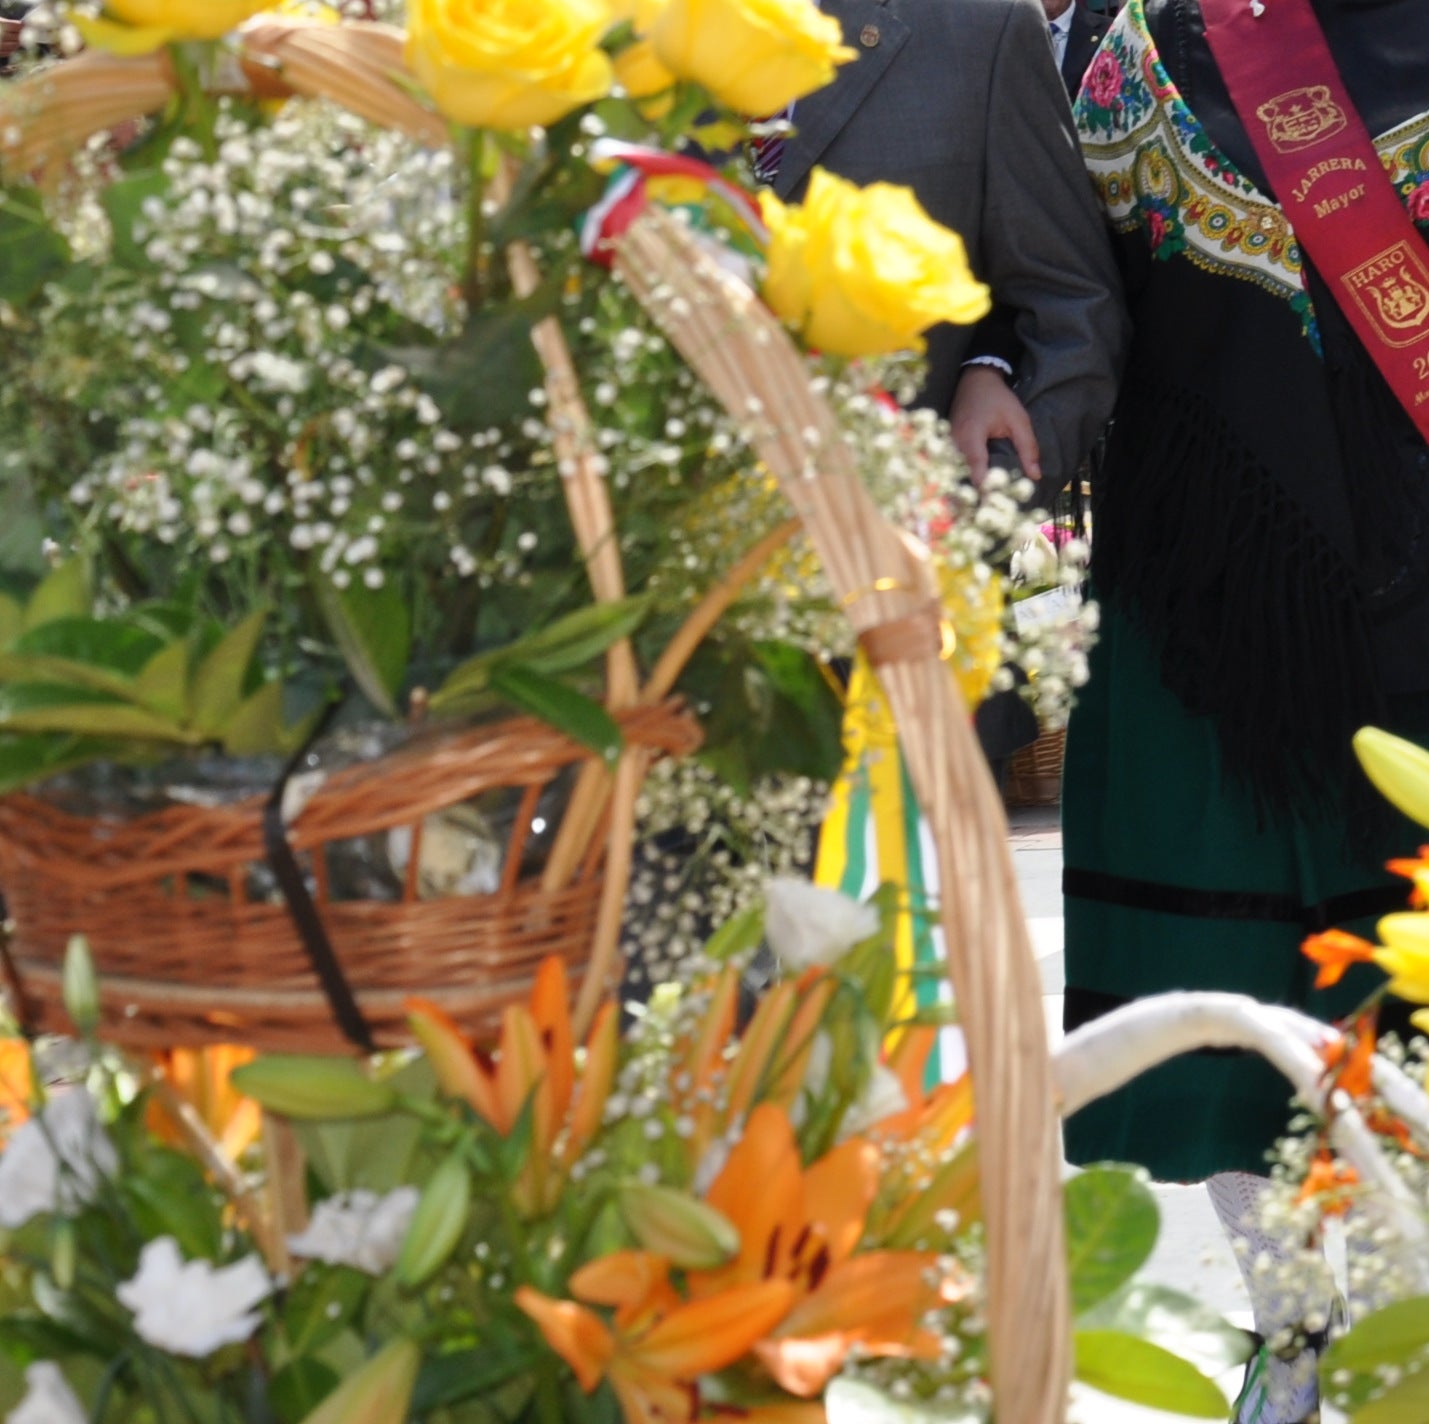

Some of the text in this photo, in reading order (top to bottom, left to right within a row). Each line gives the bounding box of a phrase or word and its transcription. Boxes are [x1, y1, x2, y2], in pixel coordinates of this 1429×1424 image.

[1291, 157, 1367, 203] JARRERA
[1313, 183, 1366, 219] Mayor
[1352, 250, 1405, 288] HARO
